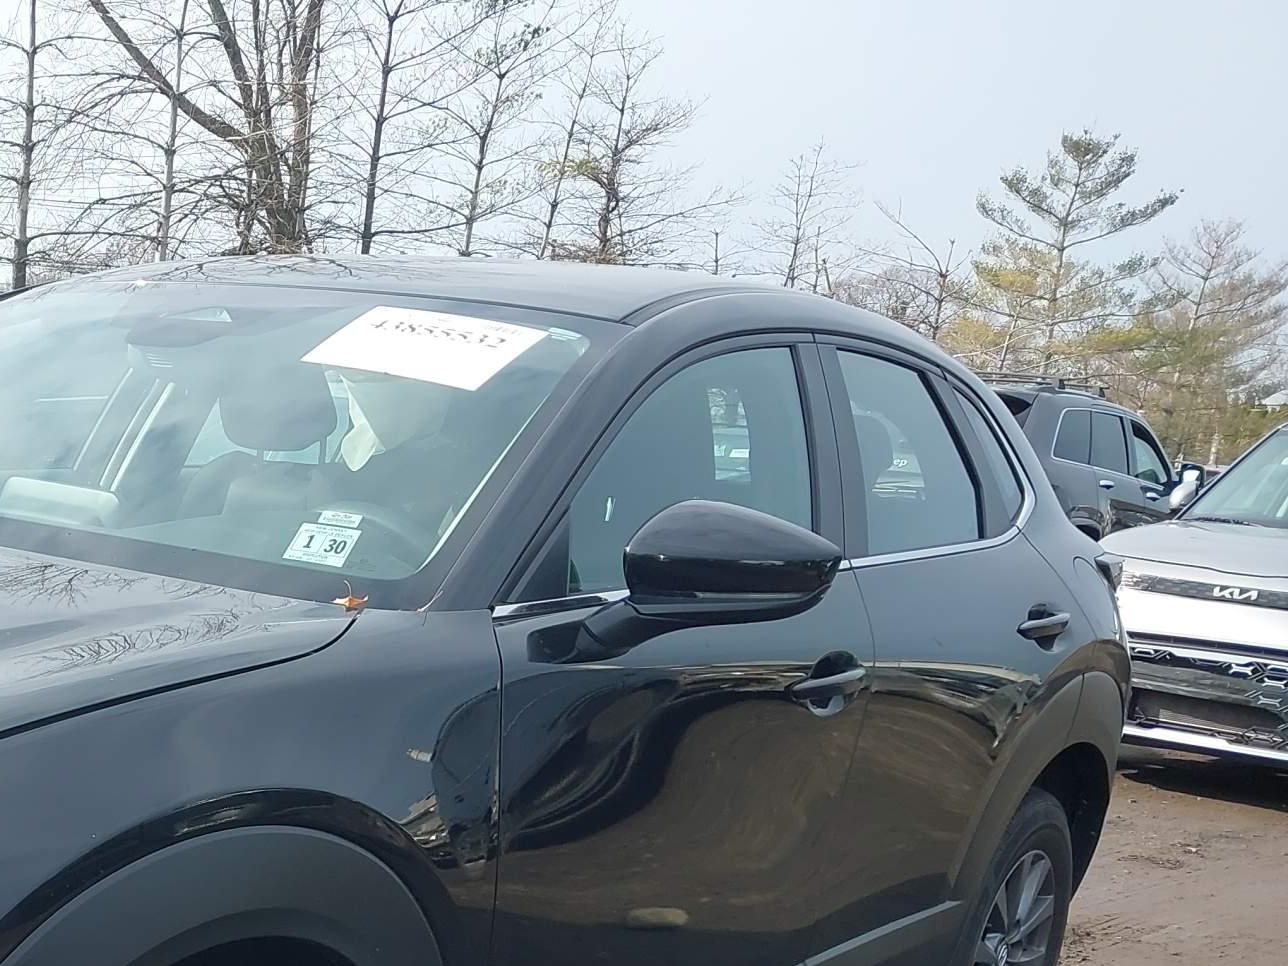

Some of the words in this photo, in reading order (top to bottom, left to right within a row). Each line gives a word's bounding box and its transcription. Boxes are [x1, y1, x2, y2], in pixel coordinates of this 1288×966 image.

[302, 534, 316, 549] 1
[323, 538, 348, 555] 30
[1213, 586, 1259, 601] KIA
